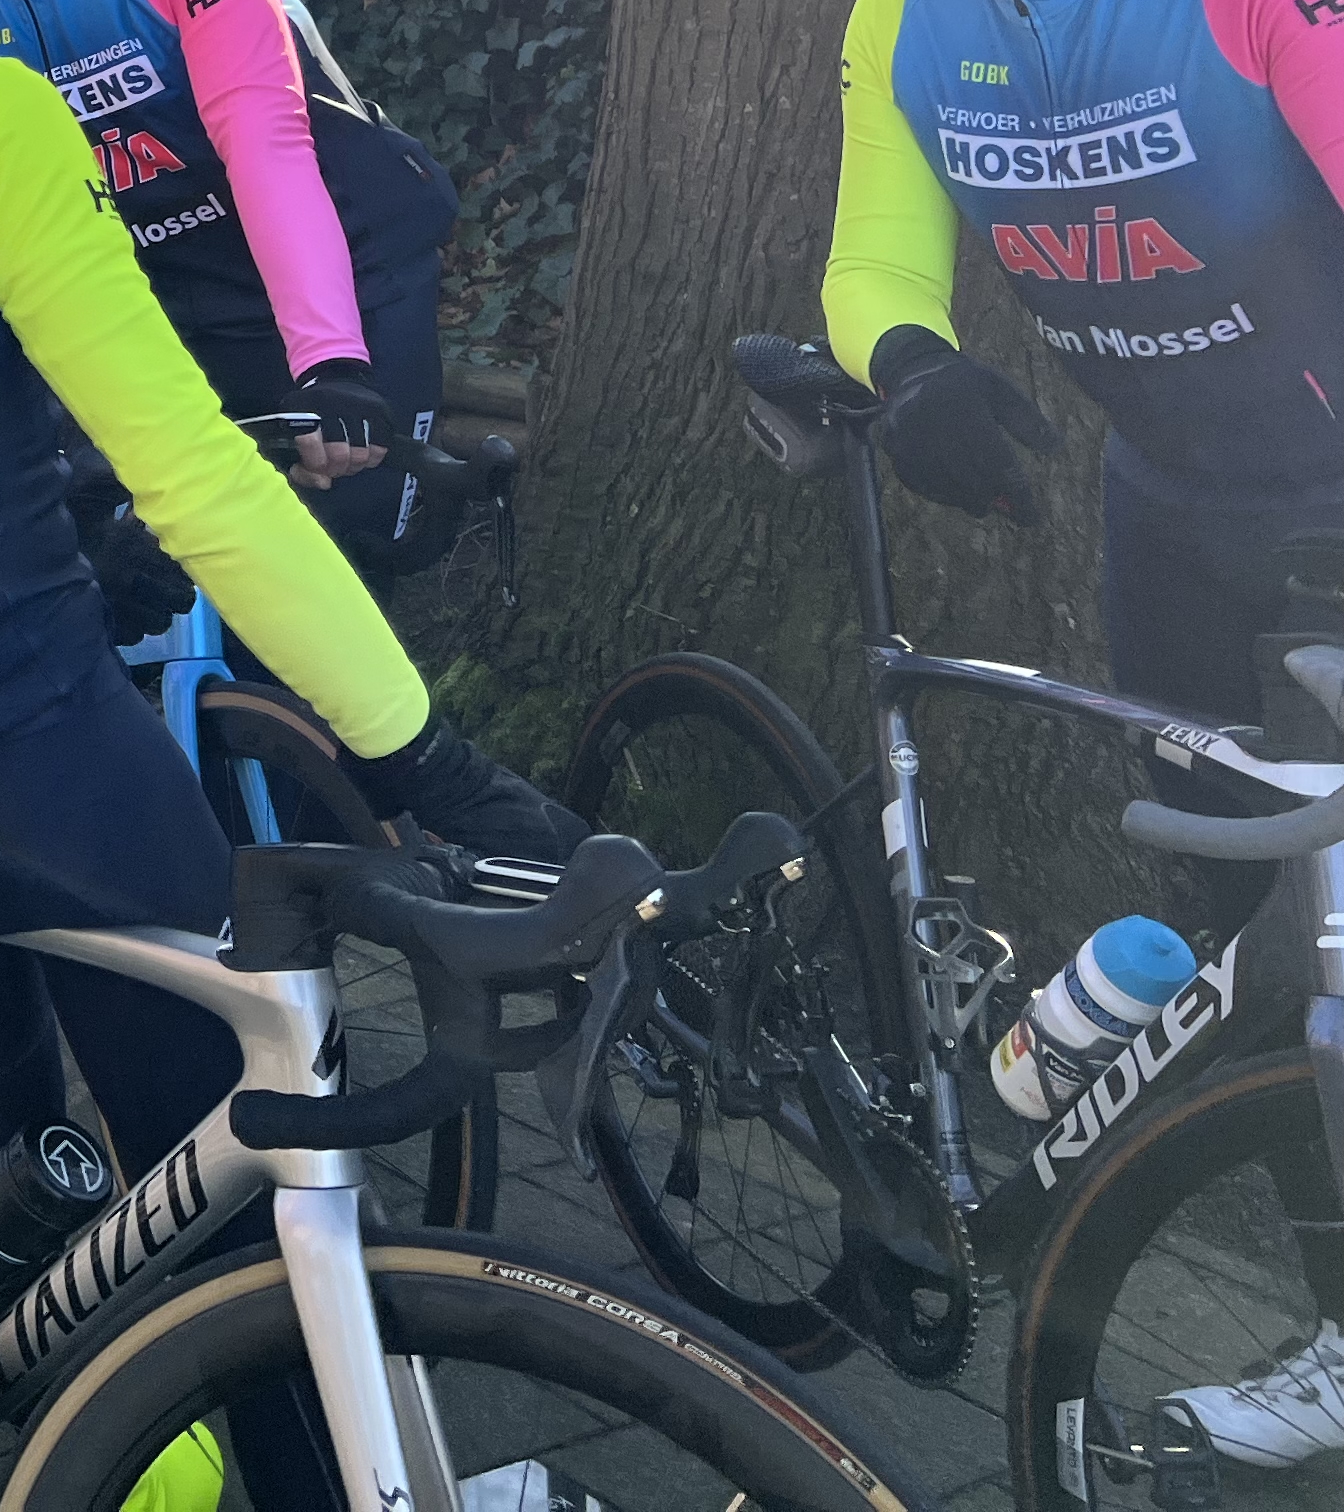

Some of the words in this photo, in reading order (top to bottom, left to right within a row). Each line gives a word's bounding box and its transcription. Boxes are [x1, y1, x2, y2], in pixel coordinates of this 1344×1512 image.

[61, 64, 154, 118] KENS
[937, 104, 1021, 131] VERVOER
[944, 121, 1182, 183] HOSKENS
[991, 205, 1207, 284] AVIA
[1160, 722, 1220, 755] FENIX
[1032, 928, 1245, 1191] RIDLEY
[585, 1294, 680, 1345] CORSA
